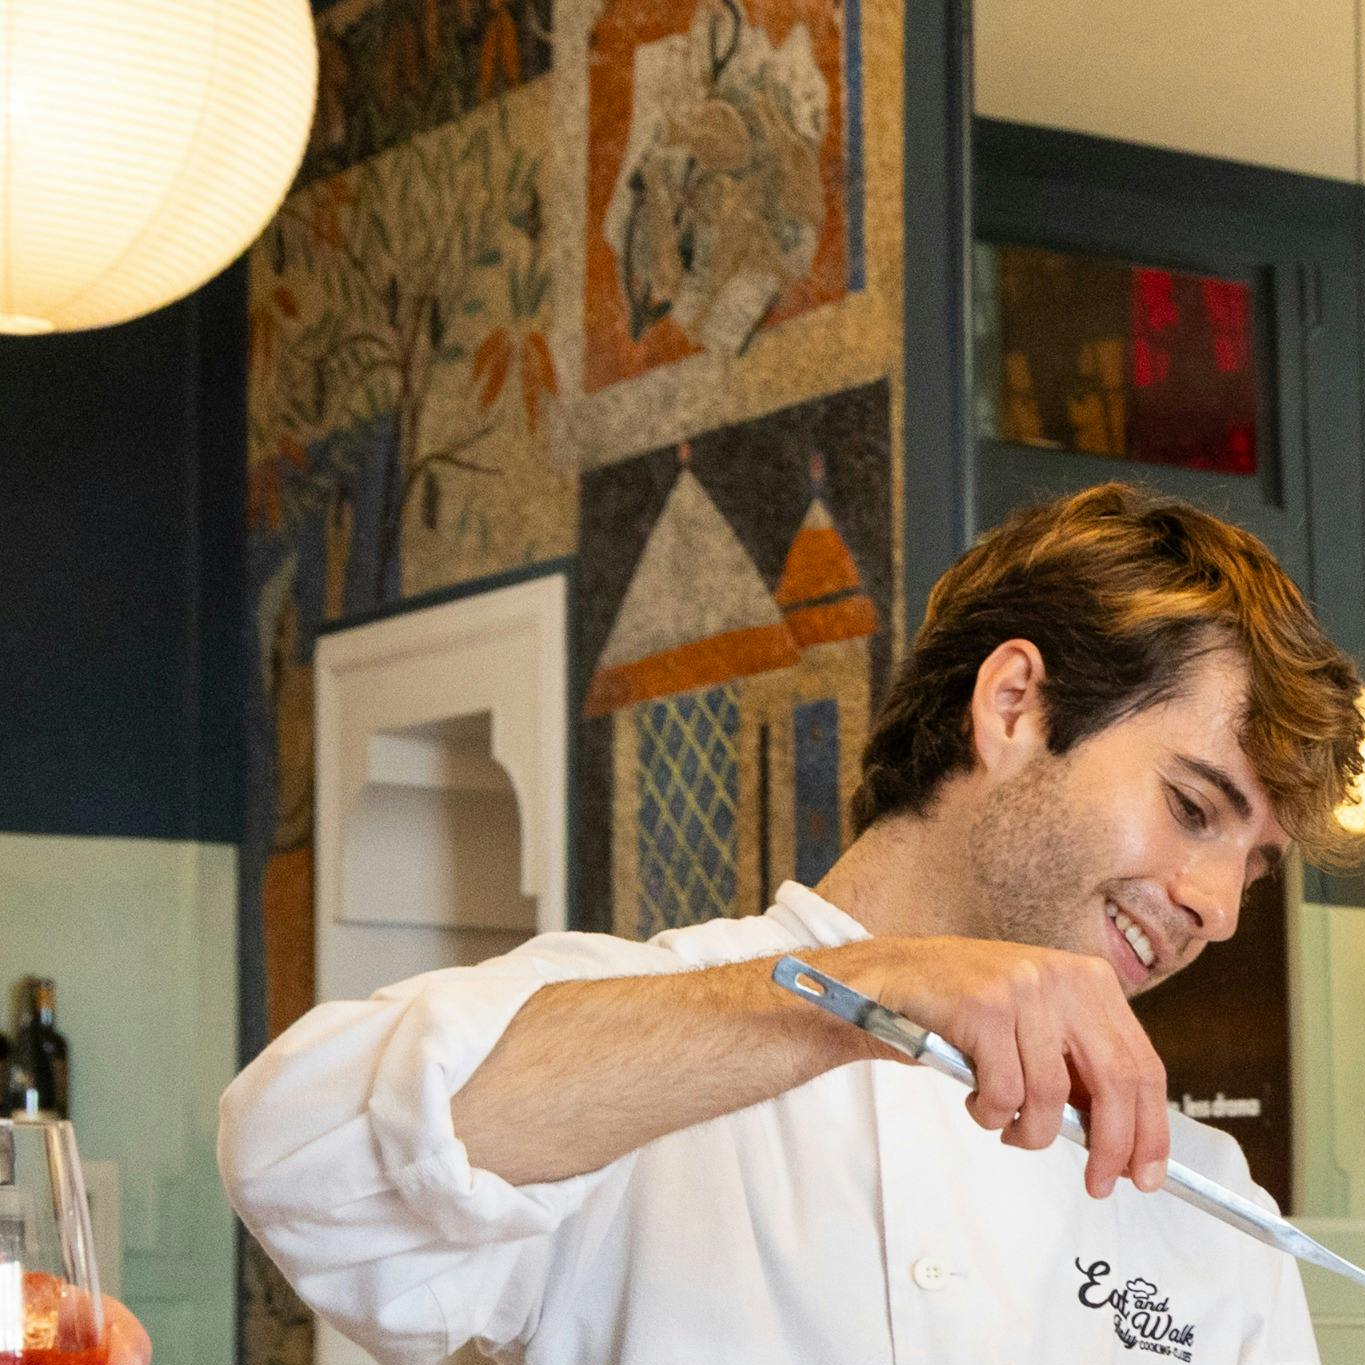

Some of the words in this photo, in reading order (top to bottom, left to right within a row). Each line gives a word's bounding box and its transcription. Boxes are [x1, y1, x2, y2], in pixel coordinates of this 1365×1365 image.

[1075, 1256, 1131, 1319] Eat
[1134, 1297, 1170, 1312] and
[1131, 1311, 1195, 1347] Walk
